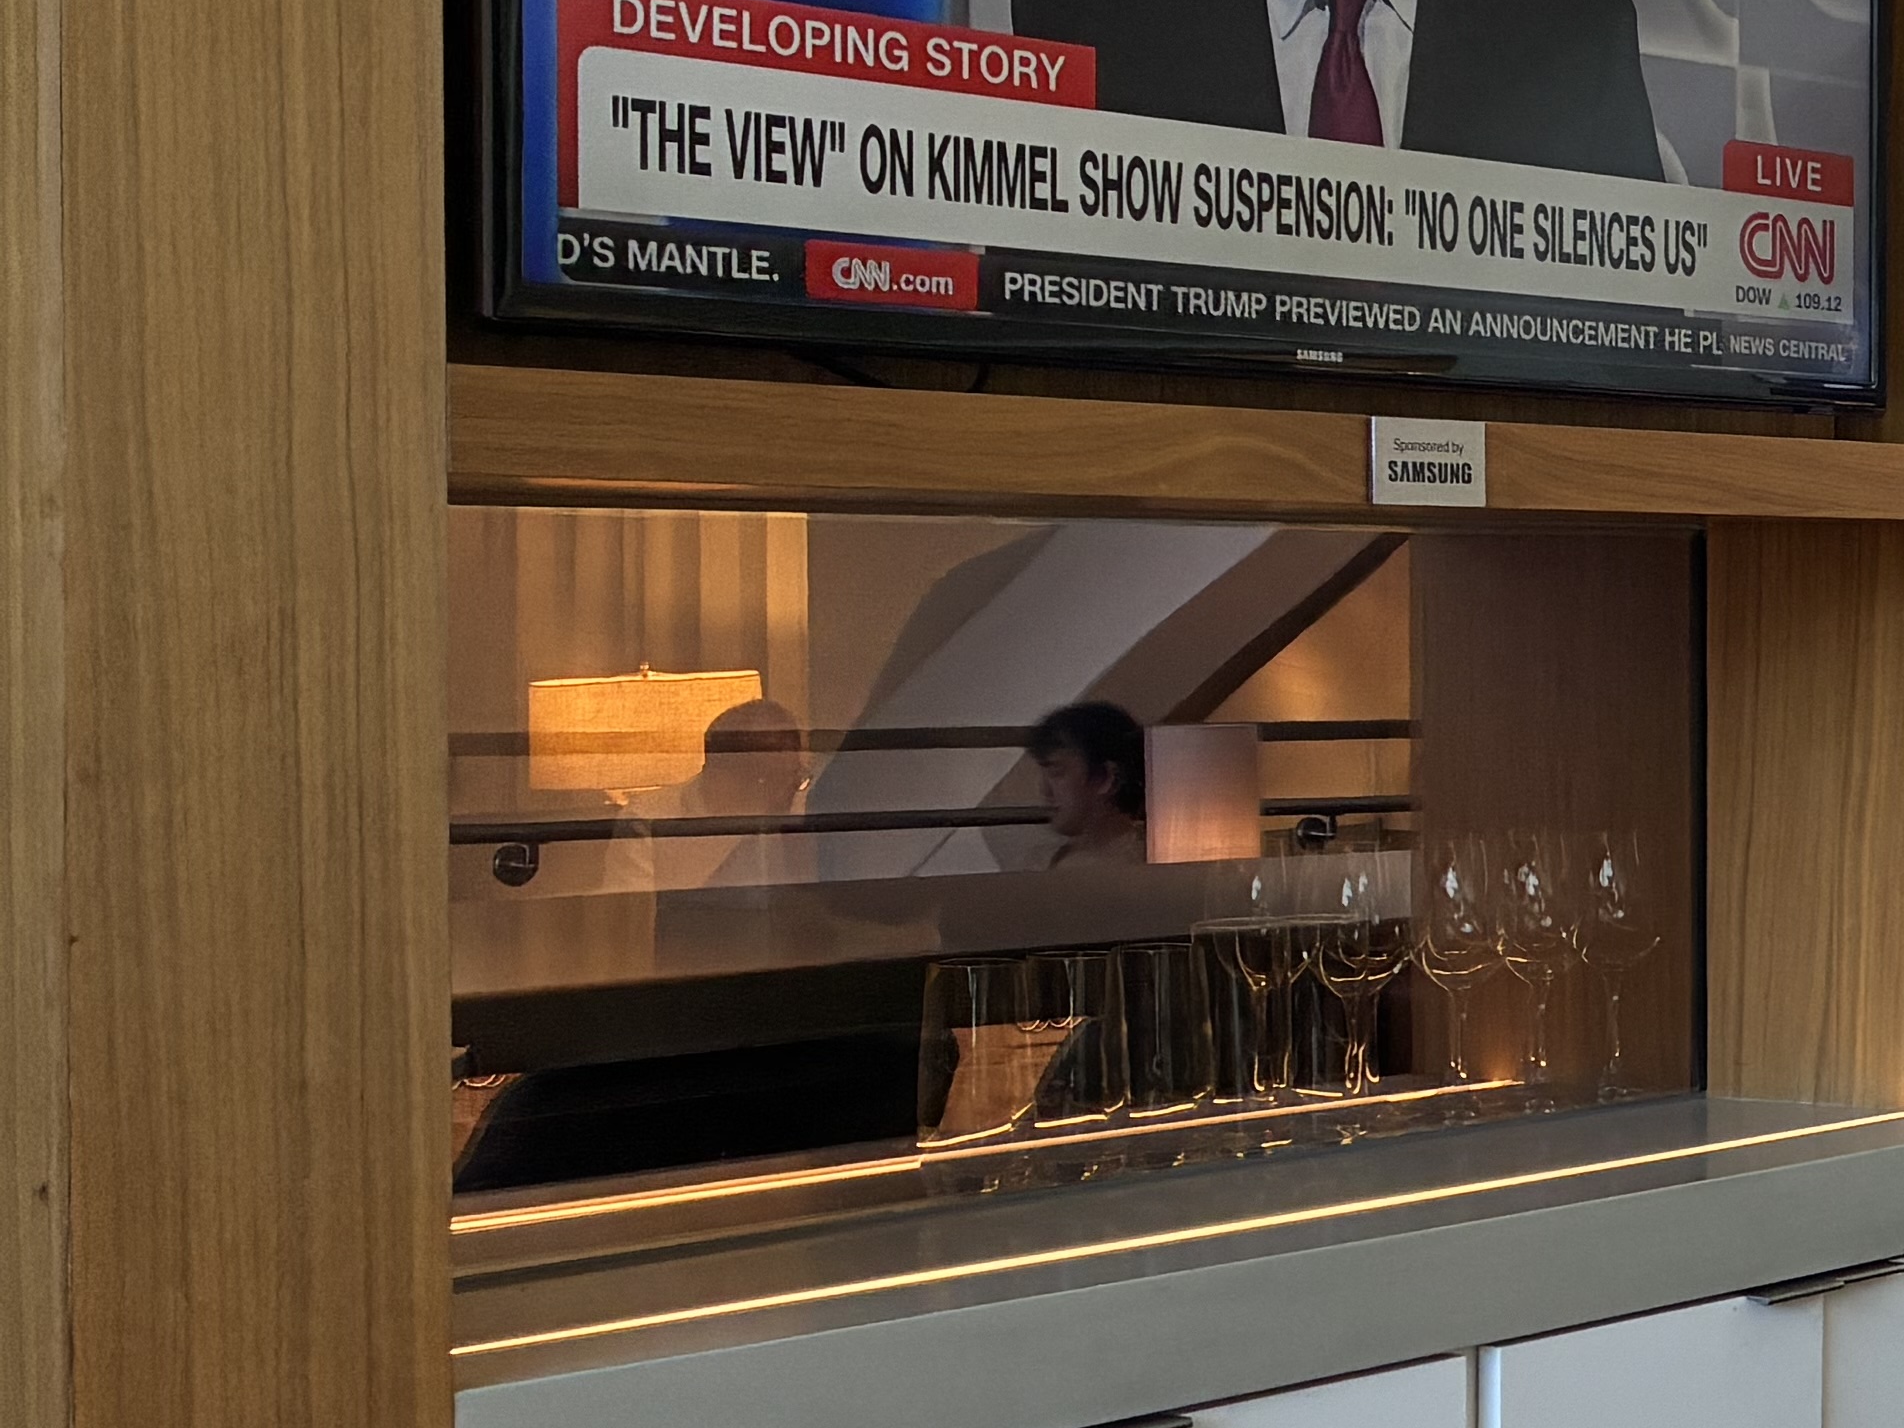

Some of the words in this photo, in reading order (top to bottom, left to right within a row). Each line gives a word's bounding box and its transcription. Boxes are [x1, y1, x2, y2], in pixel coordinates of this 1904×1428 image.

[926, 36, 1066, 92] STORY
[611, 94, 712, 178] "THE
[725, 108, 846, 189] VIEW"
[859, 123, 914, 198] ON
[927, 131, 1069, 214] KIMMEL
[1079, 149, 1184, 225] SHOW
[1193, 162, 1395, 247] SUSPENSION:
[1404, 188, 1460, 253] "NO
[1468, 195, 1526, 260] ONE
[1532, 202, 1656, 273] SILENCES
[1663, 218, 1708, 277] US"
[1756, 154, 1822, 192] LIVE
[627, 239, 780, 283] MANTLE.
[1739, 211, 1836, 286] CNN
[831, 256, 954, 296] CNN.com
[1004, 272, 1164, 312] PRESIDENT
[1171, 284, 1268, 320] TRUMP
[1275, 294, 1421, 332] PREVIEWED
[1428, 307, 1463, 335] AN
[1468, 314, 1659, 350] ANNOUNCEMENT
[1664, 327, 1693, 354] HE
[1735, 284, 1773, 306] DOW
[1795, 292, 1843, 313] 109.12
[1729, 334, 1776, 357] NEWS
[1778, 339, 1848, 362] CENTRAL
[1393, 438, 1450, 453] Sponsored
[1451, 440, 1465, 456] by
[1387, 460, 1473, 485] SAMSUNG
